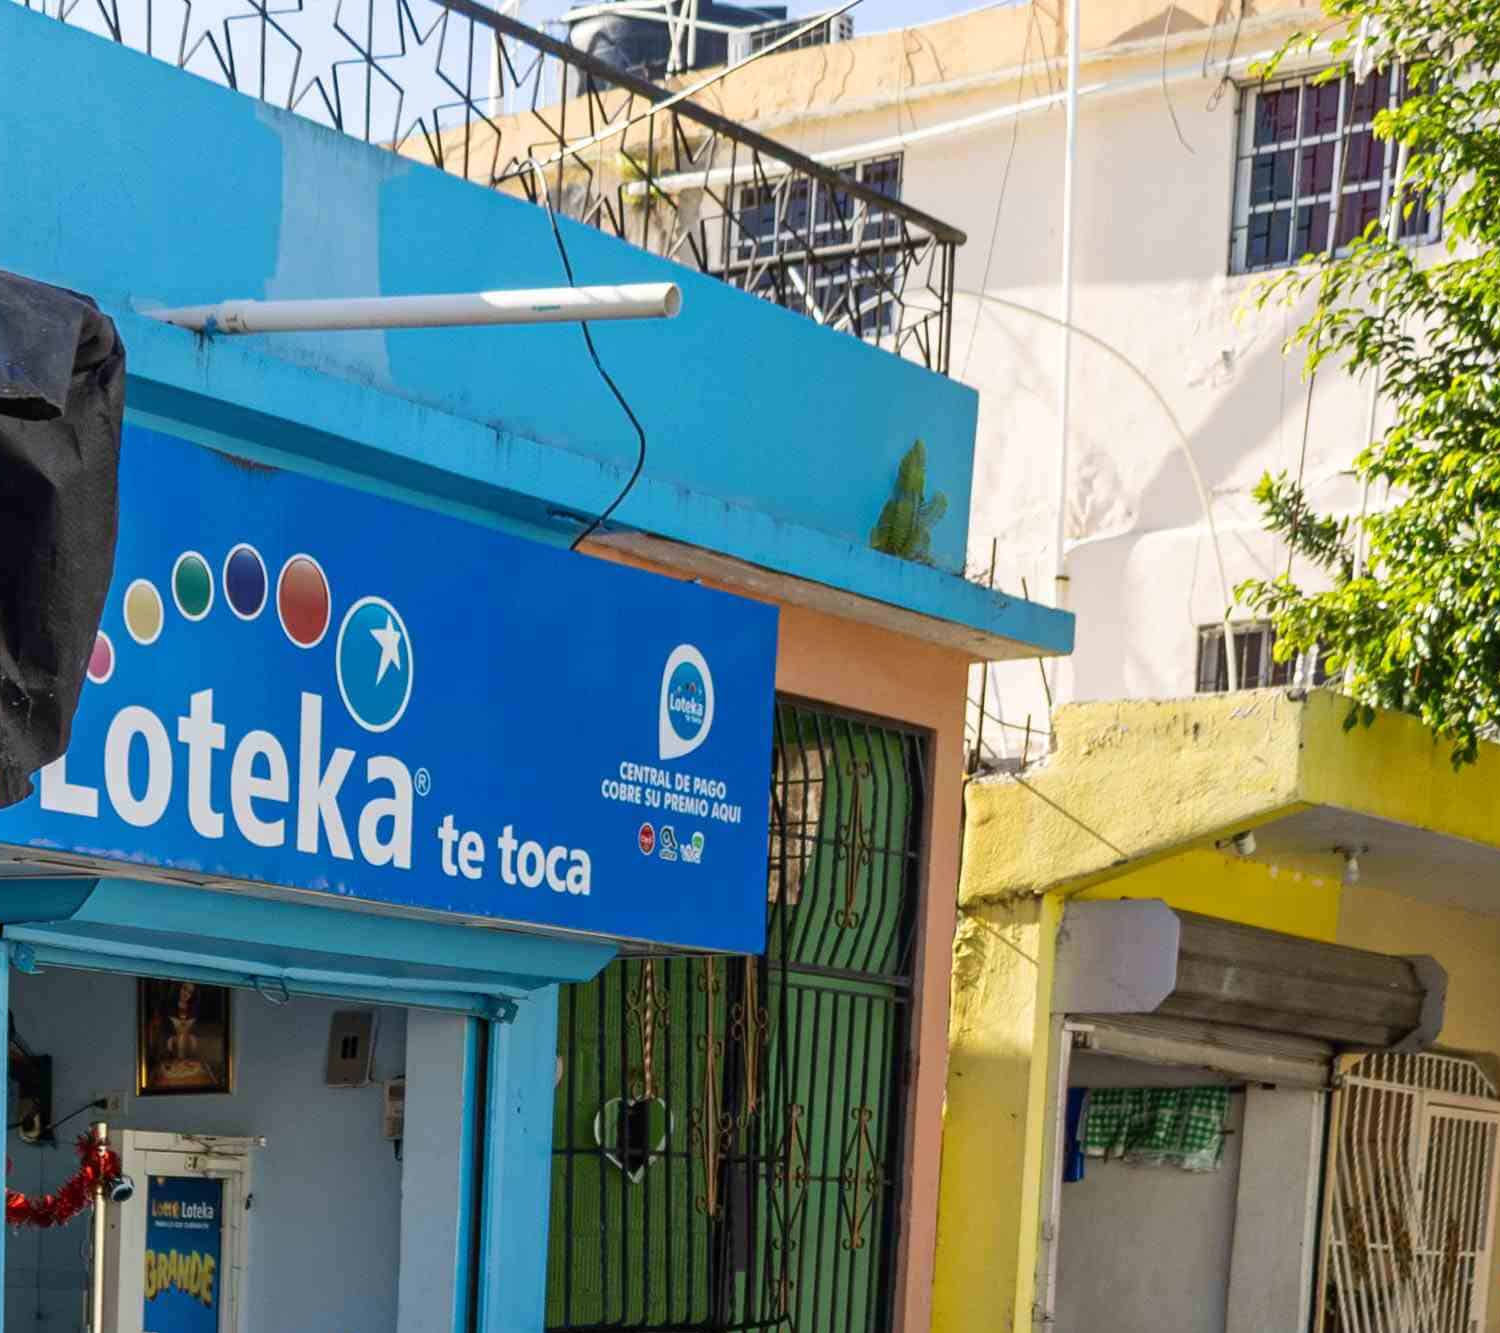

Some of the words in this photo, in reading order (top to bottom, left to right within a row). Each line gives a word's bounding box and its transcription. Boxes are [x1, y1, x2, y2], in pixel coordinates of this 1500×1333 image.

[669, 692, 704, 717] Loteka
[619, 760, 672, 789] CENTRAL
[675, 773, 690, 792] DE
[693, 776, 726, 799] PAGO
[601, 779, 641, 805] COBRE
[645, 787, 660, 808] SU
[664, 791, 709, 817] PREMIO
[711, 802, 742, 824] AQUI
[438, 815, 485, 880] te
[498, 824, 592, 897] toca
[181, 1200, 214, 1219] Loteka
[144, 1248, 216, 1307] GRANDE
